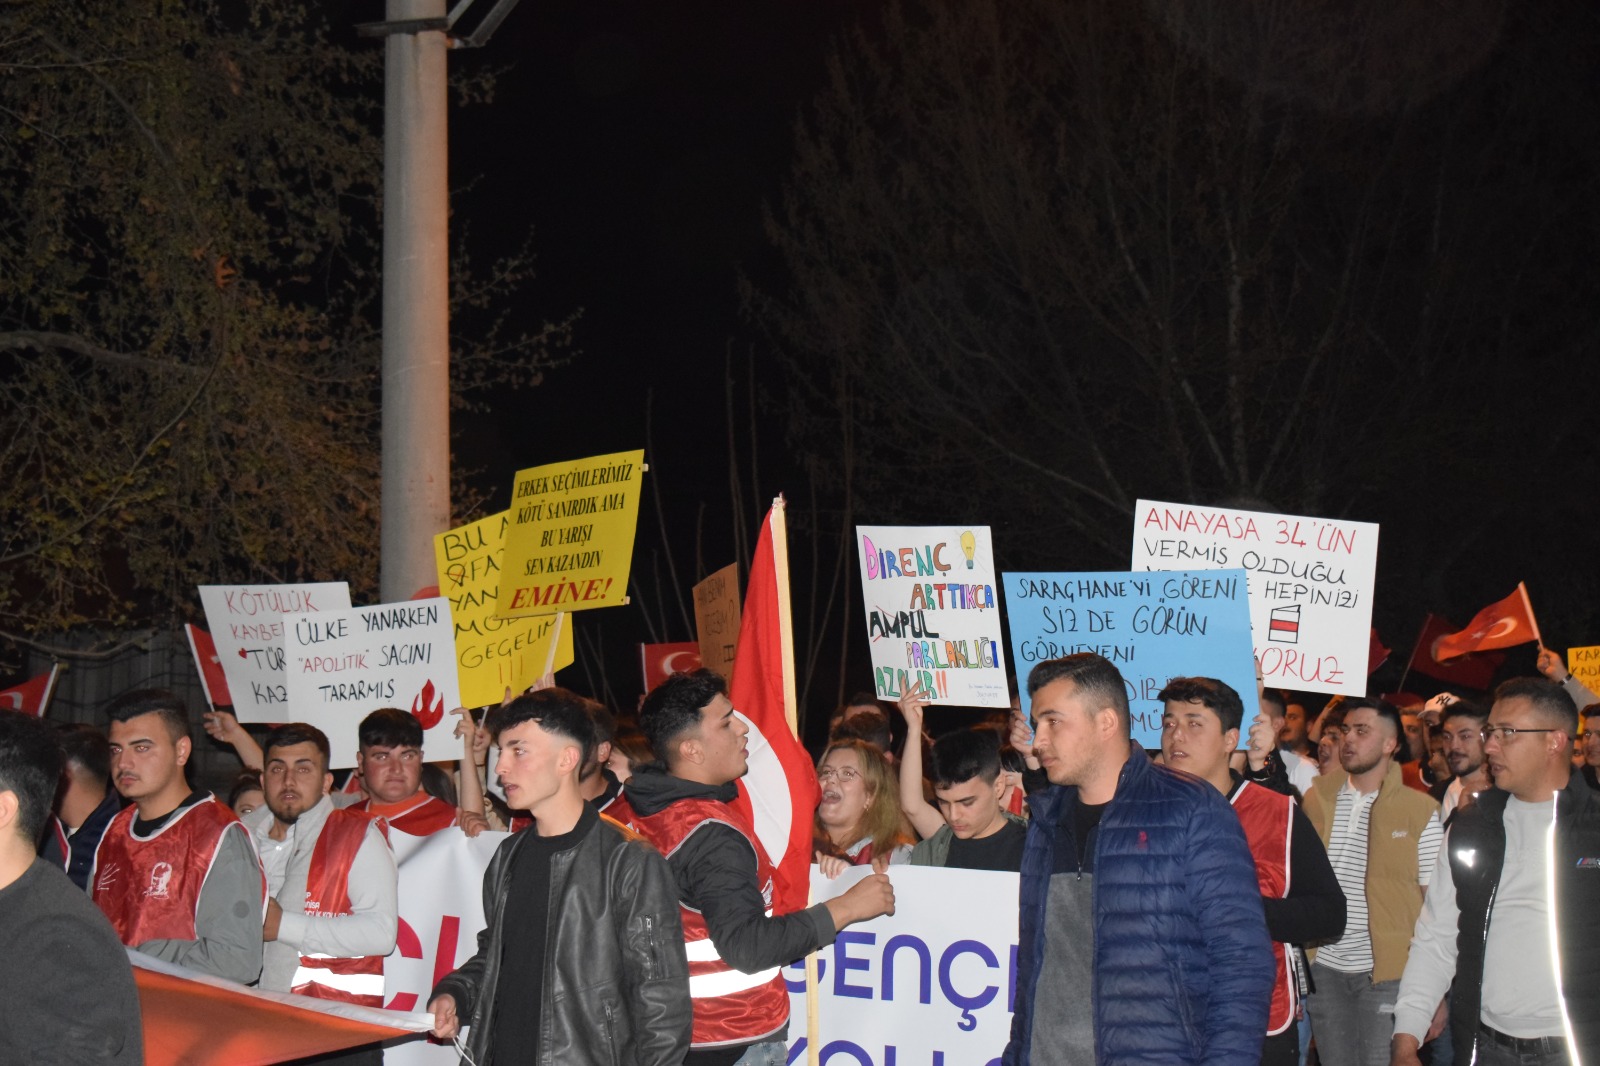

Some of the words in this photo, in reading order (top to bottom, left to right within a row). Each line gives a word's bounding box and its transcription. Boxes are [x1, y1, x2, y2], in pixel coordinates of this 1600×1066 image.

[517, 476, 551, 498] ERKEK
[551, 460, 634, 495] SEÇİMLERİMİZ
[516, 499, 546, 524] KÖTÜ
[547, 496, 599, 520] SANIRDIK
[599, 492, 626, 513] AMA
[443, 526, 488, 562] BU
[541, 529, 557, 547] BU
[558, 524, 594, 547] YARIŞI
[1144, 507, 1260, 542] ANAYASA
[1275, 520, 1356, 555] 34'ÜN
[523, 558, 547, 576] SEN
[546, 550, 603, 573] KAZANDIN
[1242, 550, 1347, 585] OLDUĞU
[223, 588, 320, 615] KÖTÜLÜK
[508, 577, 613, 610] EMİNE!
[909, 583, 995, 613] ARTTIKÇA
[1163, 573, 1237, 600] GÖRENİ
[1264, 580, 1359, 608] HEPİNİZİ
[229, 621, 285, 641] KAYBE
[296, 617, 349, 646] ÜLKE
[361, 604, 438, 632] YANARKEN
[869, 610, 940, 639] AMPUL
[1042, 605, 1079, 634] SİZ
[1086, 609, 1115, 632] DE
[1132, 597, 1208, 636] GÖRÜN
[905, 637, 1000, 669] PARLAKLIĞI
[1253, 646, 1344, 685] ORUZ
[318, 678, 395, 703] TARARMIŞ
[784, 931, 1019, 1031] ENÇ
